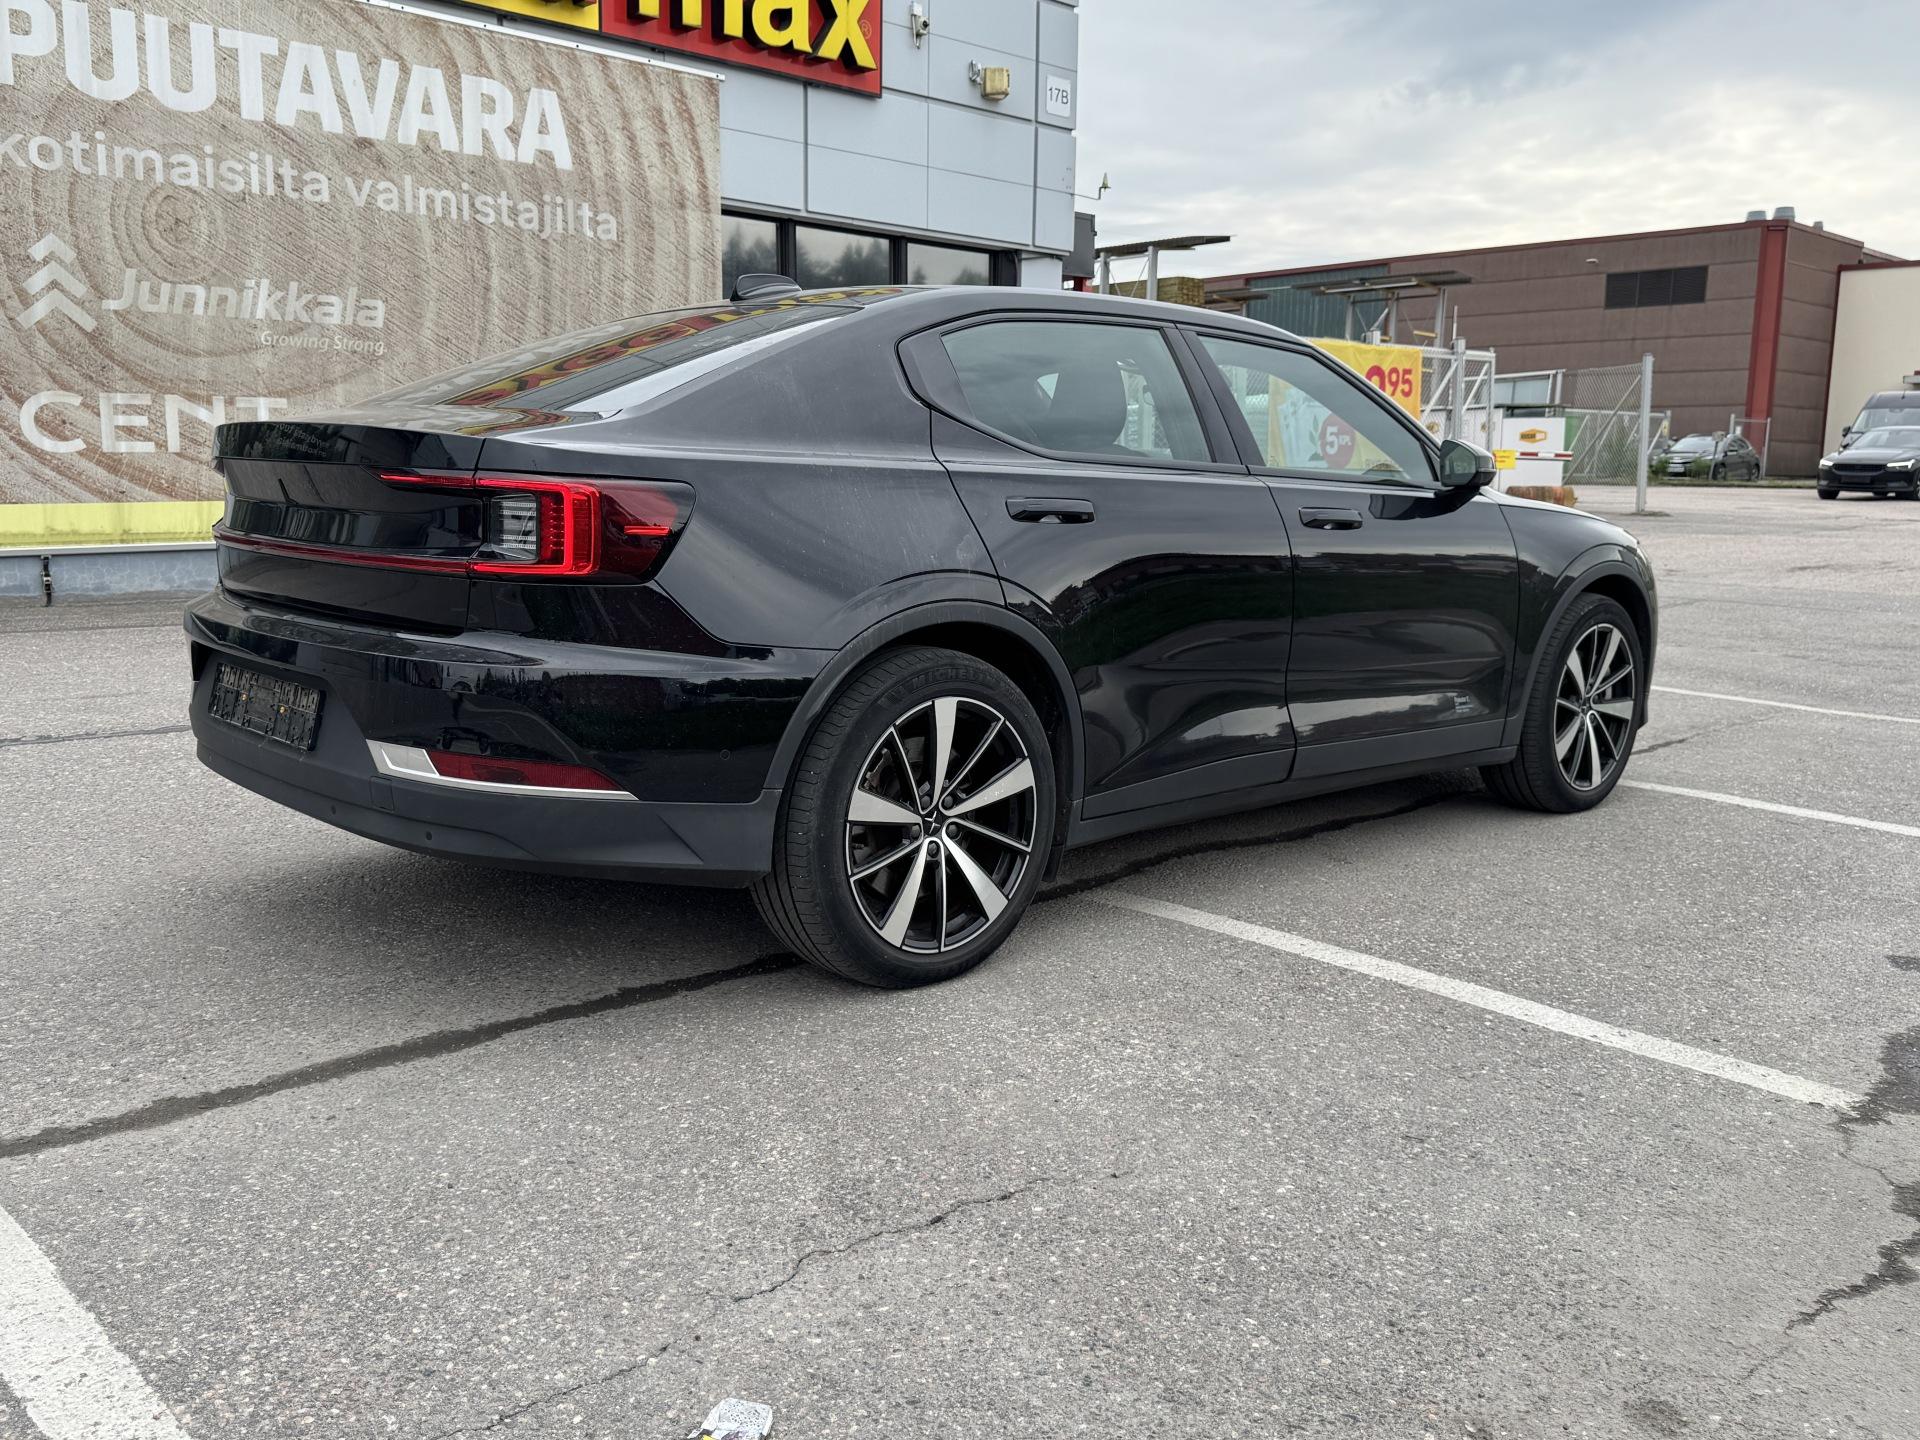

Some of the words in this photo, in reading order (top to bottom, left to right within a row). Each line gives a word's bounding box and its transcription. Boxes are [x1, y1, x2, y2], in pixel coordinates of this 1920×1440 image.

[0, 0, 573, 171] PUUTAVARA
[1048, 86, 1069, 105] 17B
[0, 131, 330, 203] kotimaisilta
[345, 174, 617, 241] valmistajilta
[102, 268, 386, 328] Junnikkala
[261, 330, 329, 353] Growing
[1325, 425, 1339, 455] 5
